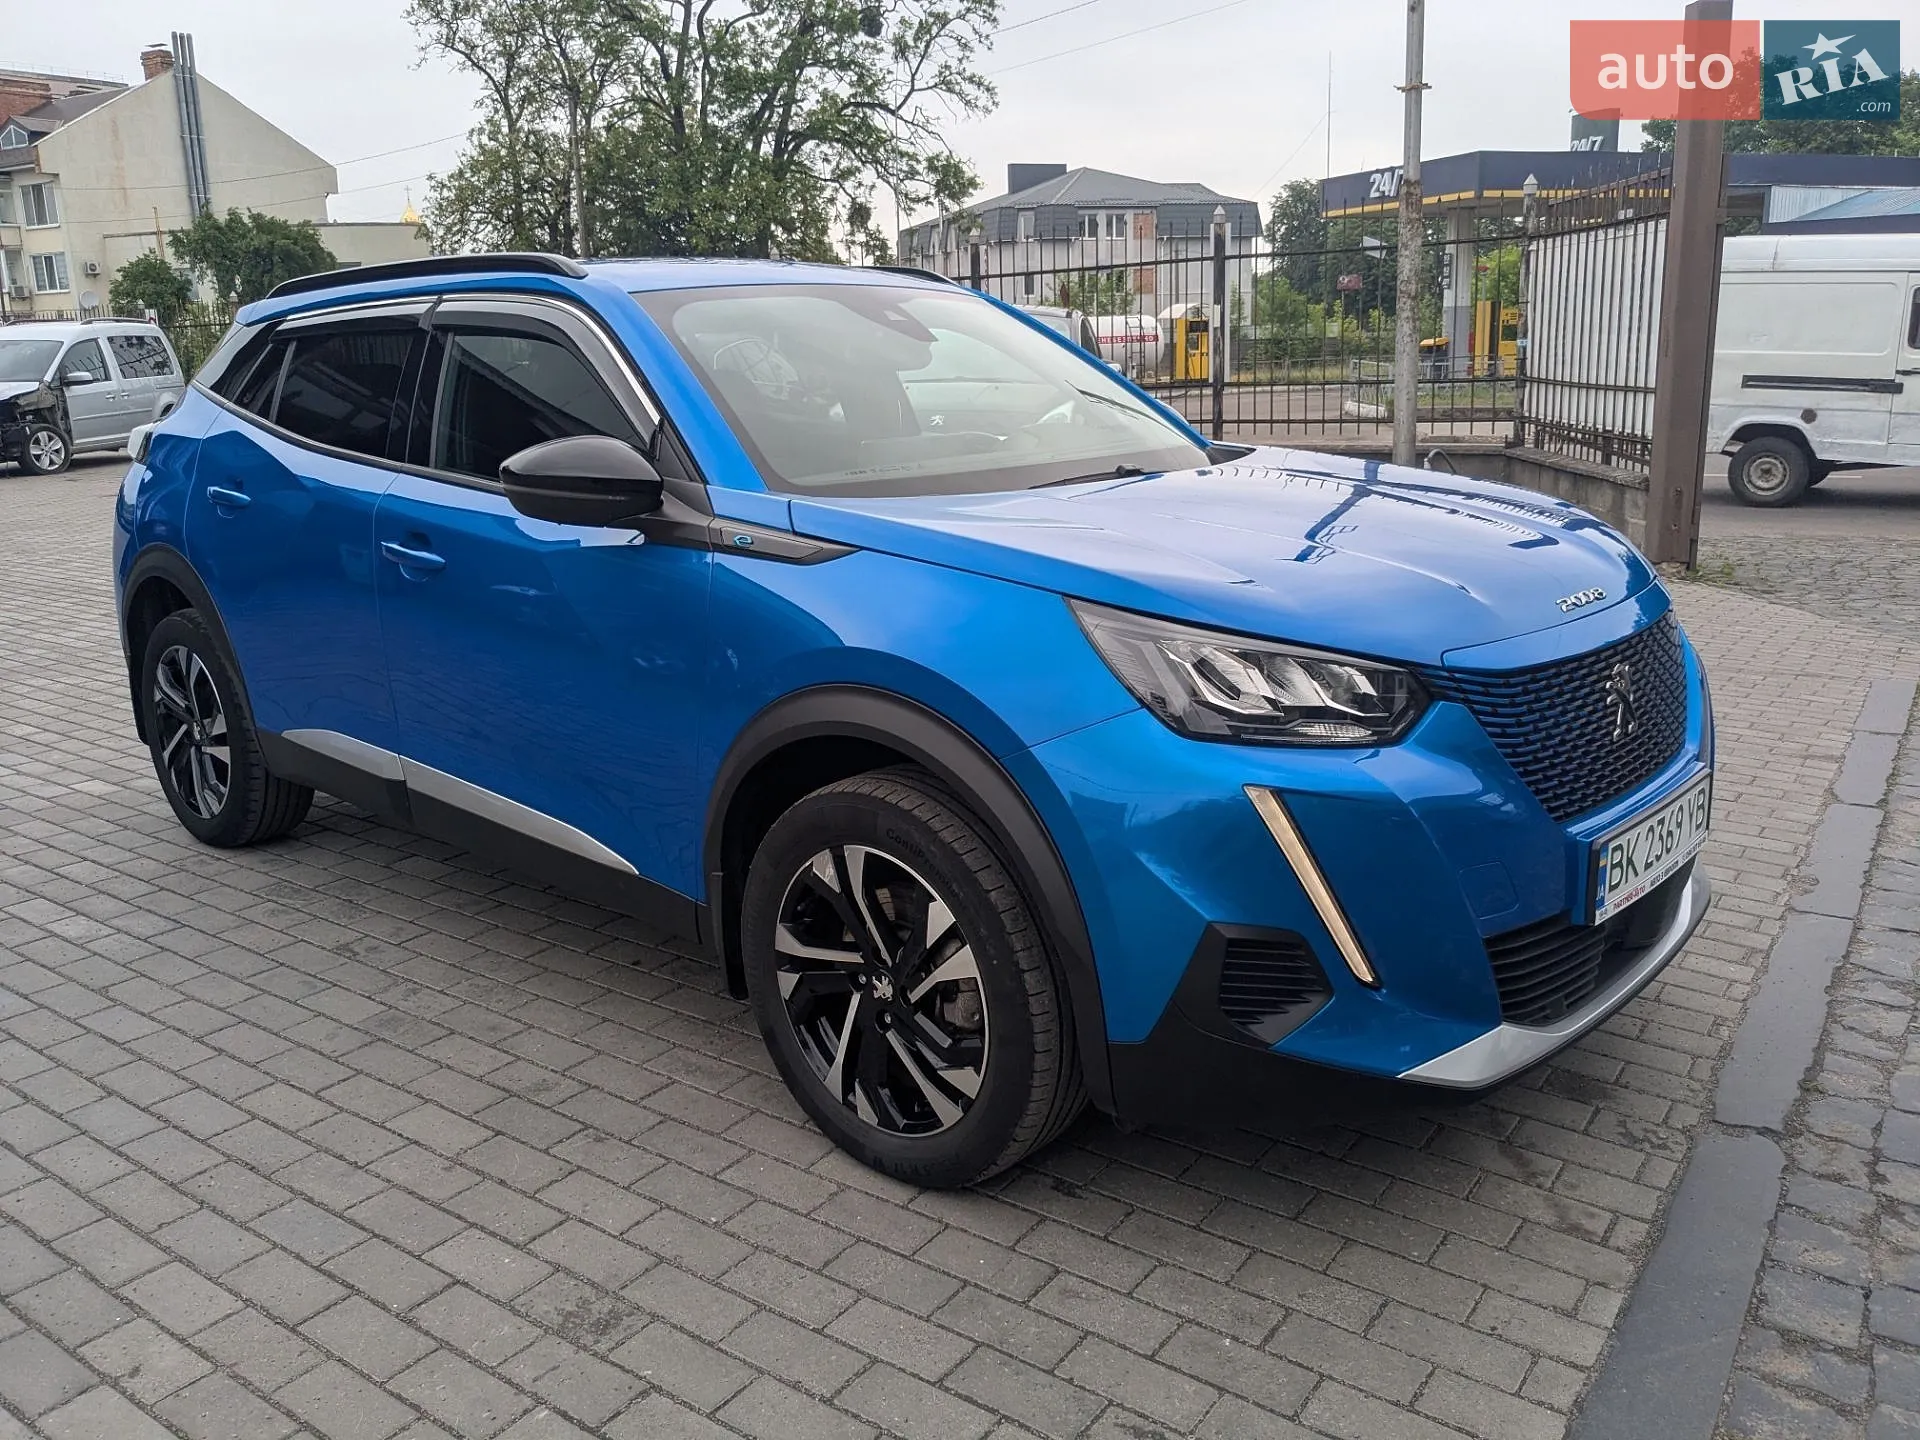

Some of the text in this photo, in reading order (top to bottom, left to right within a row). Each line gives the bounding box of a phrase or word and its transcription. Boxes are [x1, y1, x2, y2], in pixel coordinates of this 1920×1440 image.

[1555, 587, 1606, 613] 2008
[1608, 831, 1641, 893] BK
[1644, 804, 1684, 872] 2369
[1688, 786, 1706, 838] YB
